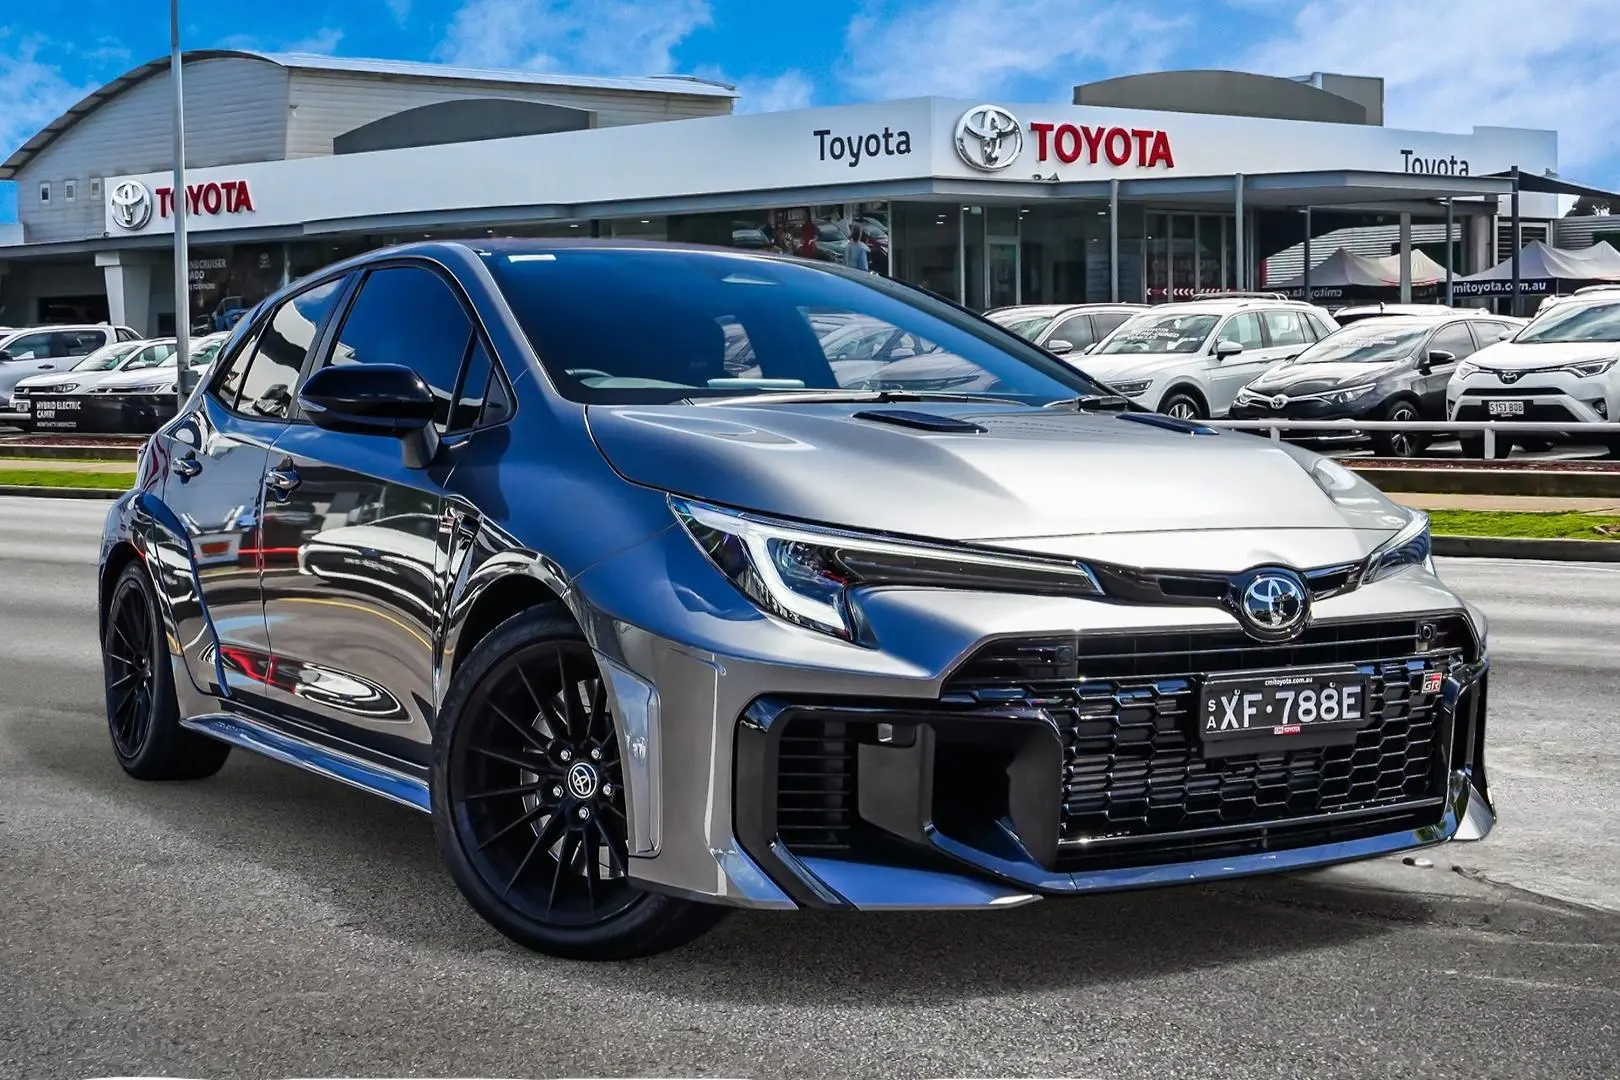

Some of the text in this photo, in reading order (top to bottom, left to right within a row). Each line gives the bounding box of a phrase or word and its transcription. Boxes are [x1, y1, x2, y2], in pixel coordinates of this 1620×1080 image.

[813, 127, 911, 167] Toyota
[1030, 122, 1174, 168] TOYOTA
[1453, 281, 1546, 295] mitoyota.cm.au
[36, 401, 57, 410] HYBRID
[57, 401, 82, 410] ELECTRIC
[1264, 677, 1313, 687] cmitoyota.com.au
